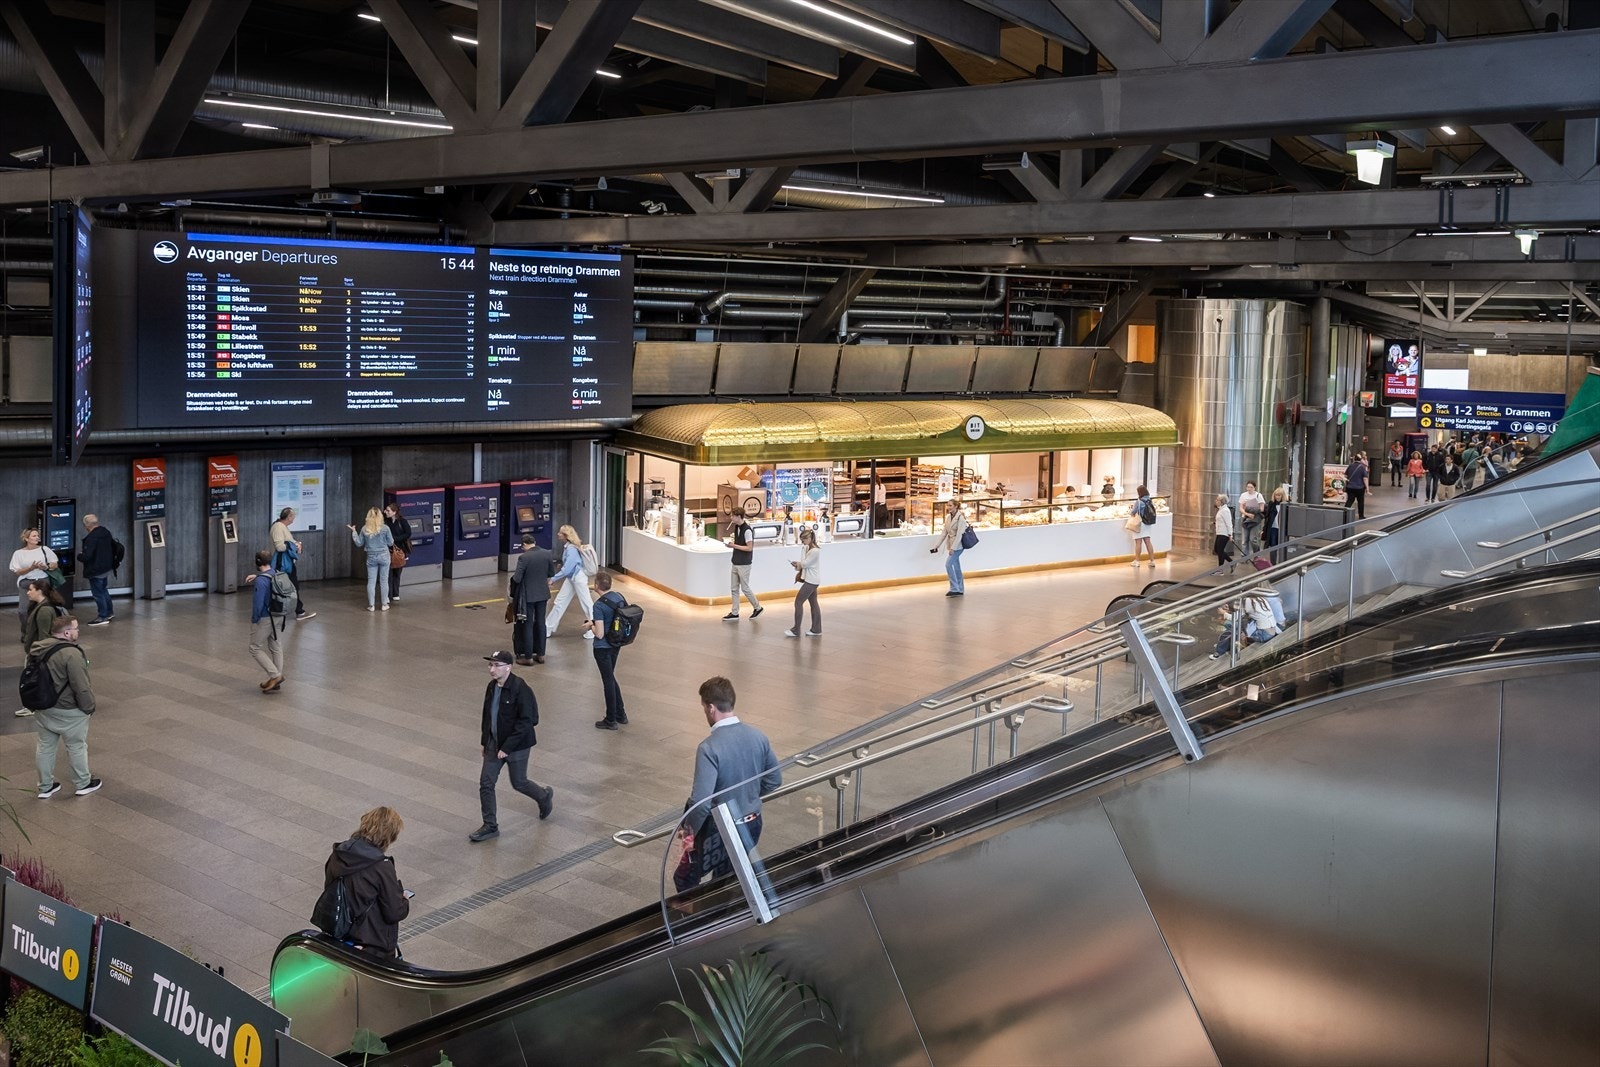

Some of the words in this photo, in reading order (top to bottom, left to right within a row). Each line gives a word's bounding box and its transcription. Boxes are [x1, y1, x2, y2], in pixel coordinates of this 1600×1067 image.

[187, 246, 258, 264] Avganger
[262, 250, 338, 265] Departures
[440, 258, 456, 269] 15
[459, 259, 475, 270] 44
[490, 262, 519, 272] Neste
[521, 263, 537, 275] tog
[540, 265, 573, 276] retning
[576, 266, 620, 277] Drammen
[489, 301, 503, 310] Nå
[574, 303, 587, 313] Nå
[489, 346, 494, 354] 1
[497, 346, 516, 355] min
[574, 346, 586, 355] Nå
[488, 389, 502, 399] Nå
[572, 389, 579, 398] 6
[580, 389, 598, 398] min
[1454, 405, 1472, 415] 1-2
[1505, 408, 1551, 417] Drammen
[39, 904, 56, 917] MESTER
[12, 924, 60, 971] Tilbud
[110, 957, 133, 974] MESTER
[110, 970, 131, 986] GRØNN
[152, 973, 231, 1060] Tilbud
